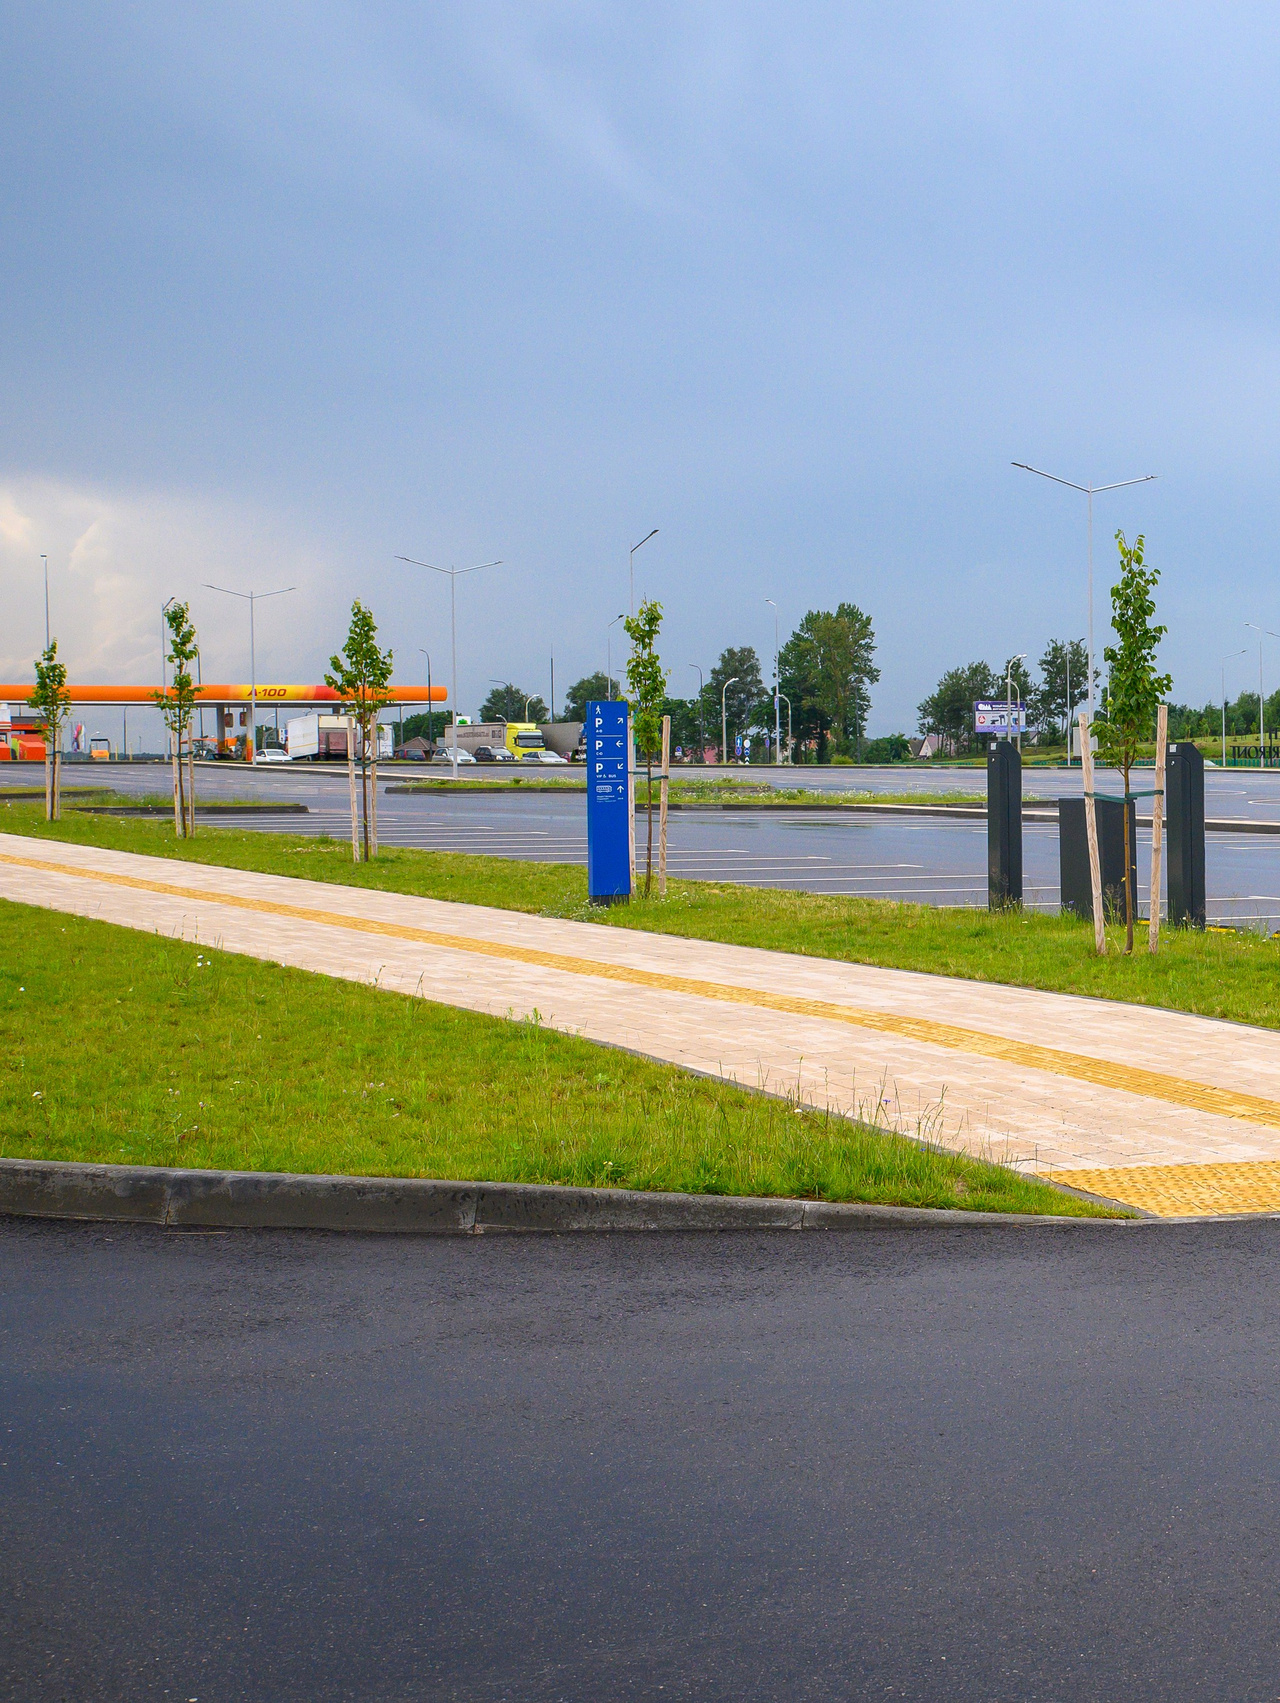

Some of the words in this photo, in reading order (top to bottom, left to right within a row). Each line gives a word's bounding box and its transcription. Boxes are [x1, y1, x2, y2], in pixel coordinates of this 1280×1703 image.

[247, 688, 287, 697] A-100
[595, 717, 603, 728] P
[595, 740, 603, 751] P
[595, 762, 604, 773] P
